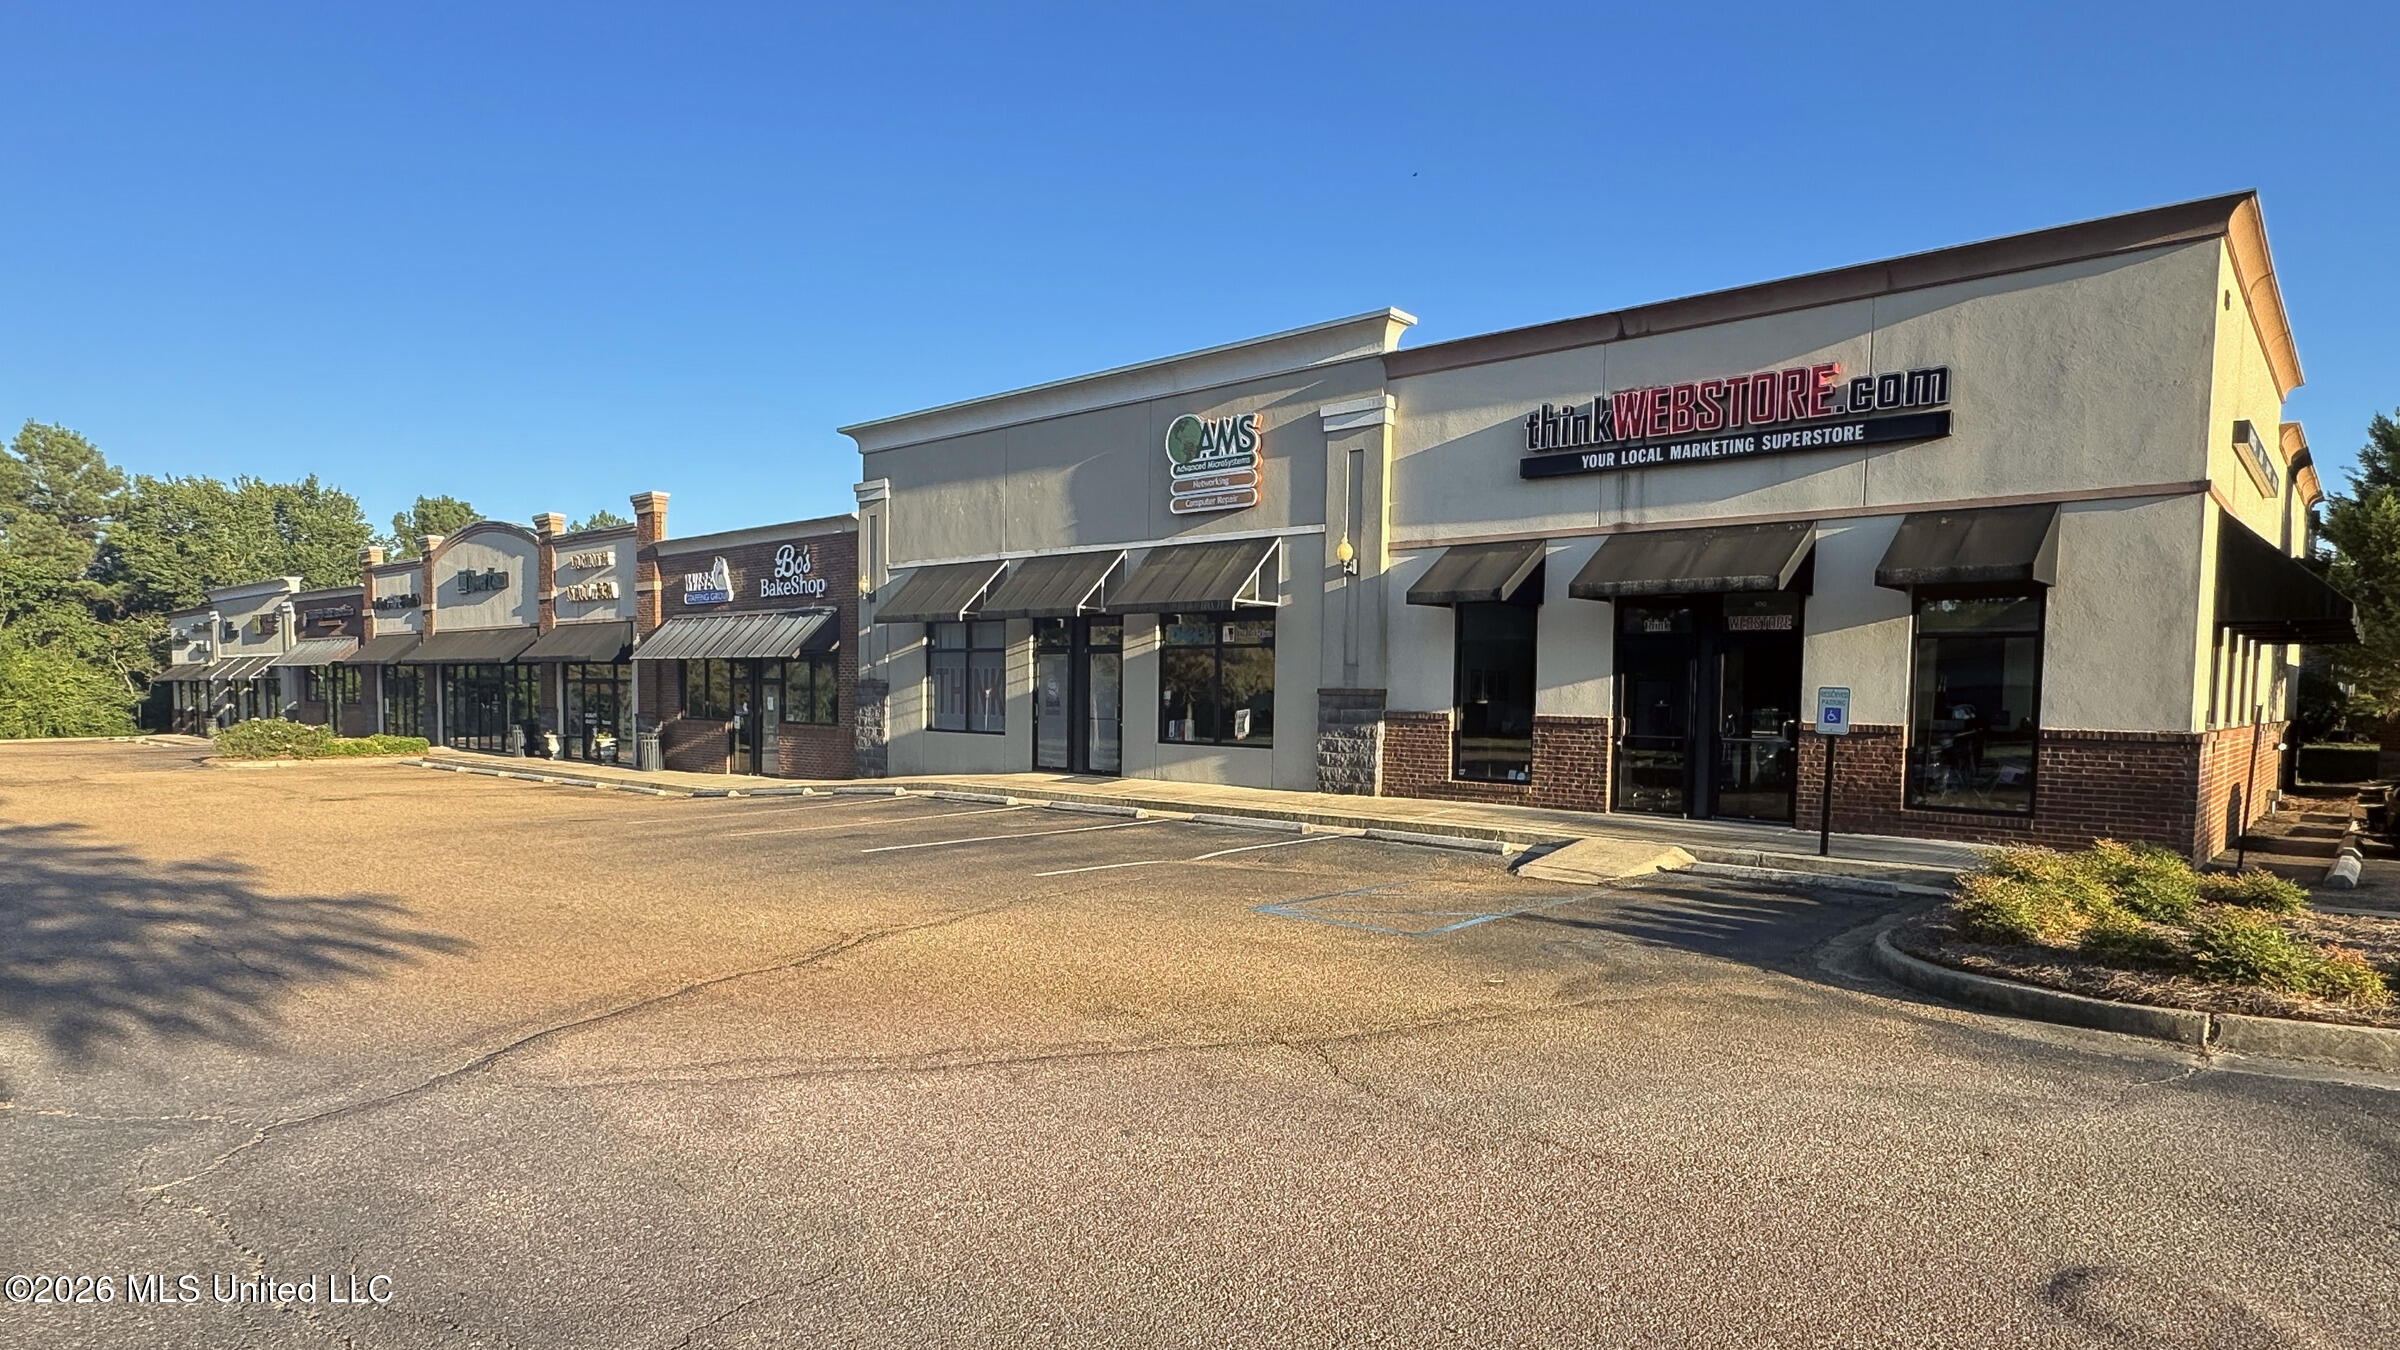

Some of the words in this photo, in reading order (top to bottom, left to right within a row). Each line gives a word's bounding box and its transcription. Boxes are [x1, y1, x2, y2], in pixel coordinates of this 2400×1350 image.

[1524, 362, 1950, 450] thinkWEBSTORE.com
[1199, 414, 1257, 457] AMS
[1582, 452, 1615, 469] YOUR
[1621, 448, 1664, 465] LOCAL
[1670, 438, 1754, 459] MARKETING
[1761, 424, 1865, 451] SUPERSTORE
[1177, 462, 1206, 473] Advanced
[1208, 457, 1250, 469] MicroSystems
[1193, 477, 1229, 488] Networking
[1185, 498, 1216, 509] Computer
[1216, 494, 1239, 505] Repair
[774, 544, 811, 578] Bo's
[760, 575, 826, 599] BakeShop
[1728, 615, 1792, 630] WEBSTORE
[935, 667, 1005, 716] THINK
